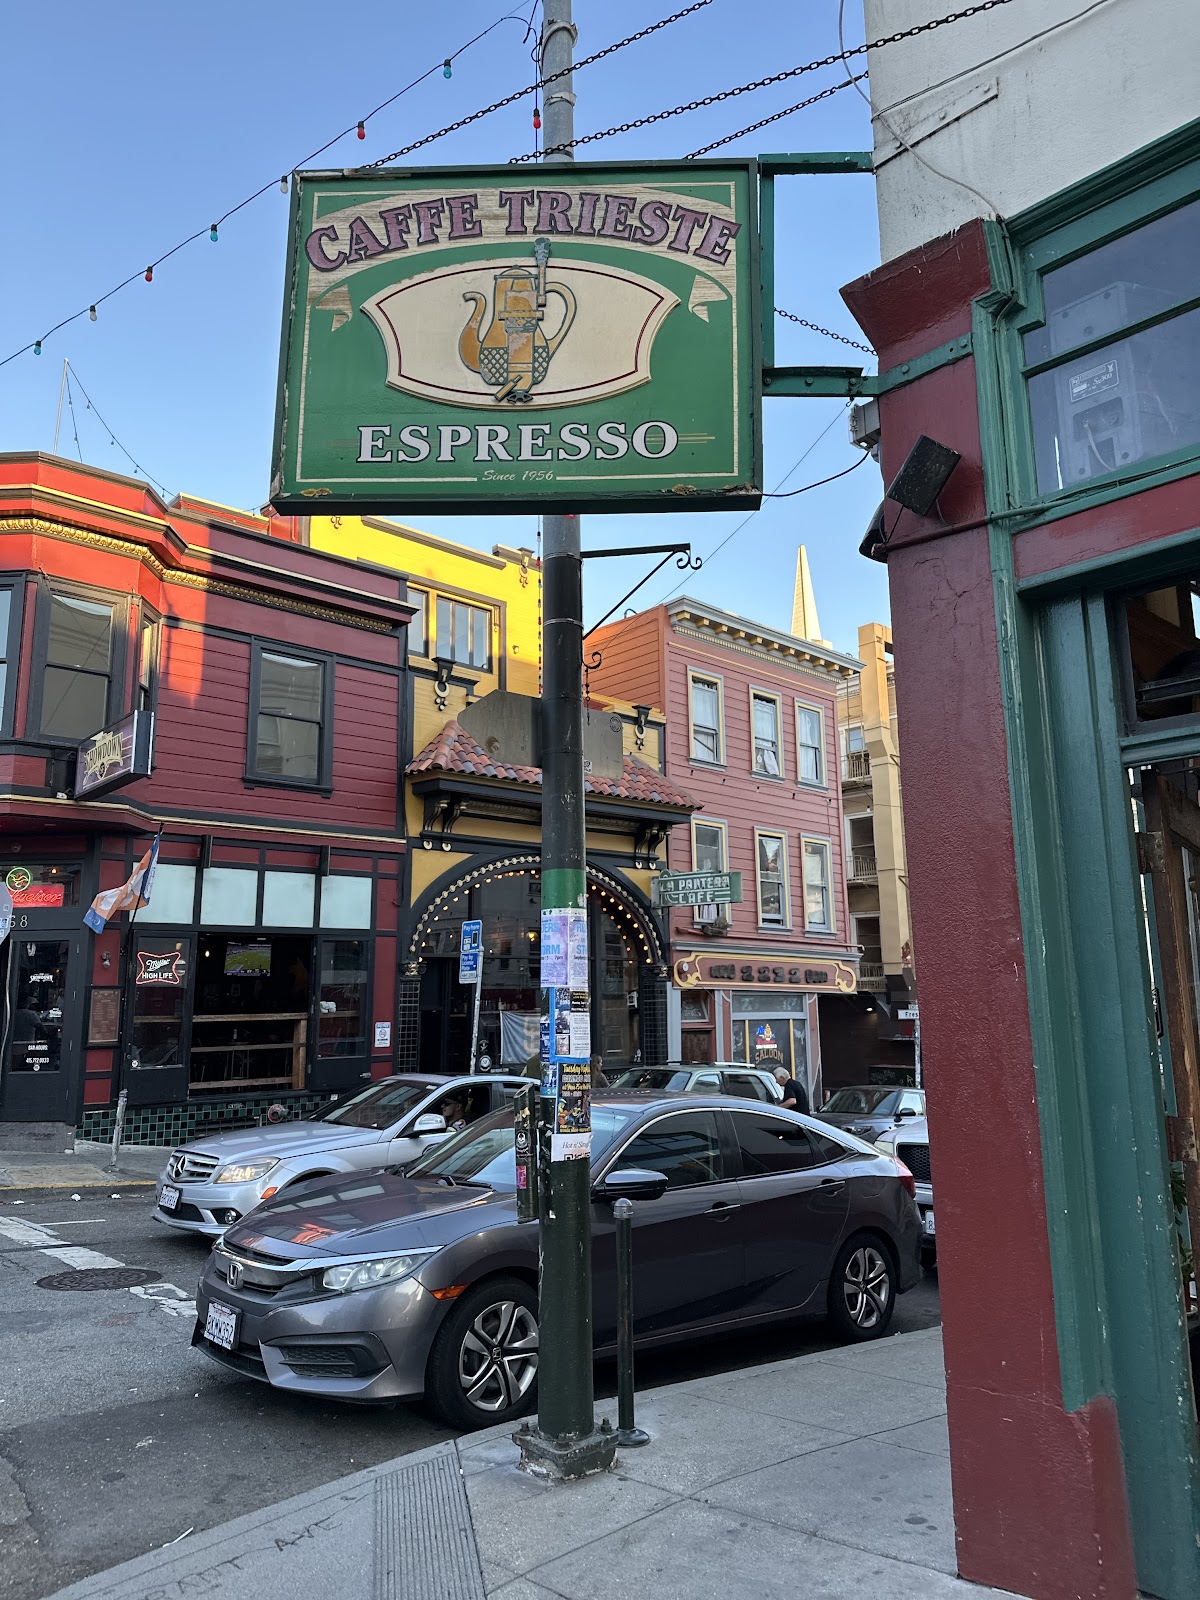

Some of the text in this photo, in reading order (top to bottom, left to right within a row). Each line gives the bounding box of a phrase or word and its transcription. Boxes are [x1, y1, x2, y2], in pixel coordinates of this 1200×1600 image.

[305, 190, 742, 272] CAFFE TRIESTE
[356, 421, 678, 463] ESPRESSO
[482, 470, 553, 482] Since 1956
[86, 733, 123, 772] SHOWDOWN
[679, 876, 729, 891] PANTERA
[10, 889, 61, 903] weiser
[680, 891, 713, 904] CAFE
[755, 1048, 784, 1063] SALOON
[274, 1522, 342, 1551] AVE
